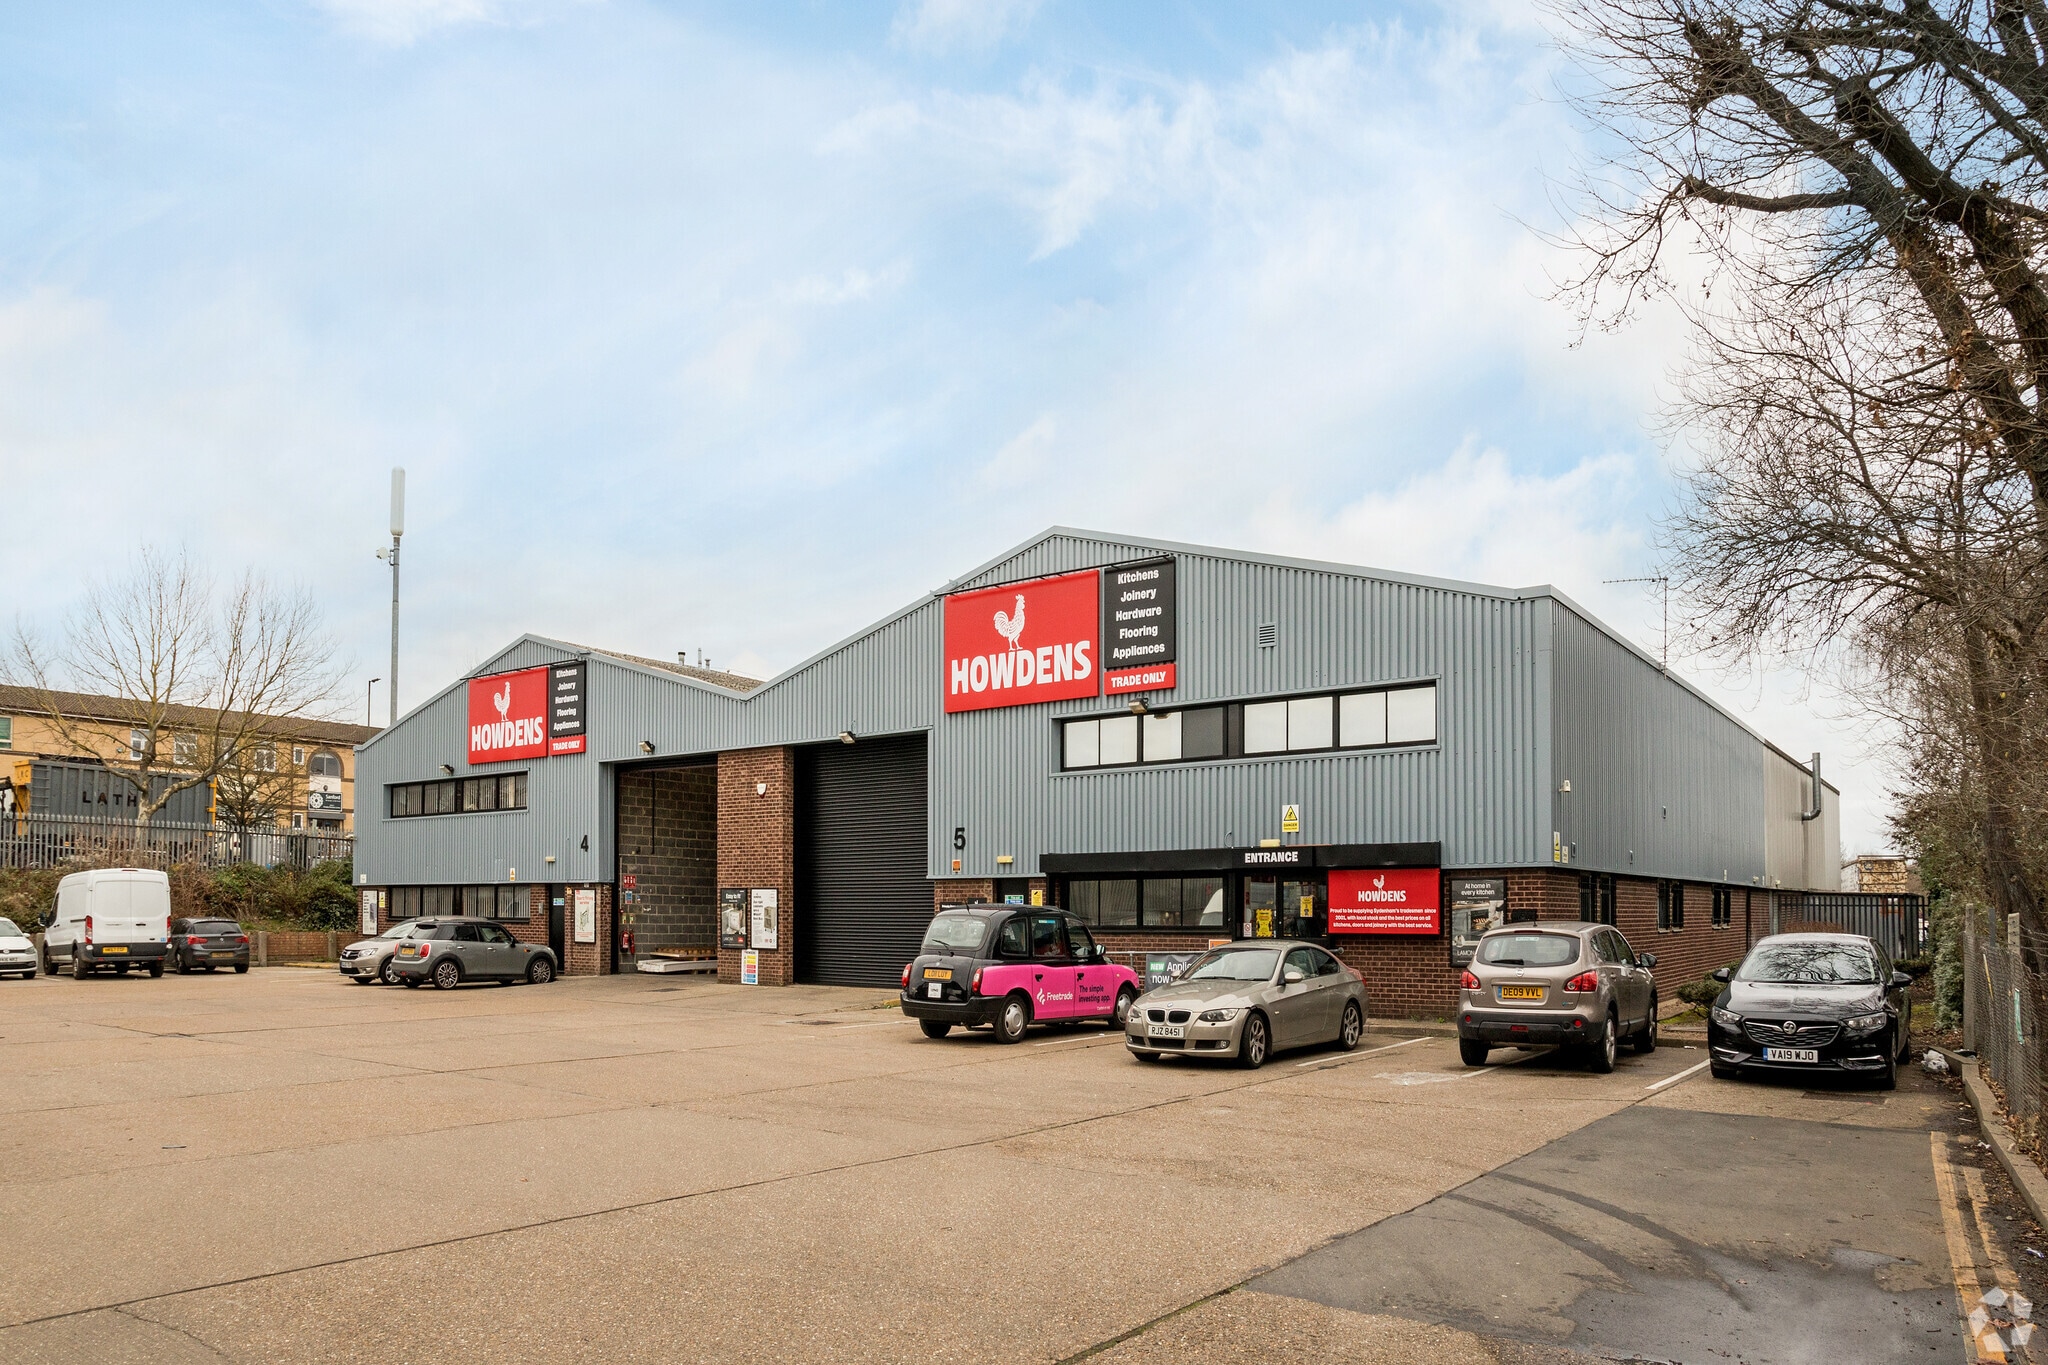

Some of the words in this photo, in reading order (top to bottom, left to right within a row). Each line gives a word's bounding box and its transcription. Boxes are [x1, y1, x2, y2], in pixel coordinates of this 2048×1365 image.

[1118, 568, 1159, 584] Kitchens
[1120, 587, 1156, 602] Joinery
[1116, 605, 1162, 622] Hardware
[1119, 624, 1158, 640] Flooring
[1112, 642, 1165, 661] Appliances
[556, 668, 578, 678] Kitchens
[951, 640, 1092, 695] HOWDENS
[1111, 674, 1141, 688] TRADE
[1142, 671, 1166, 686] ONLY
[558, 682, 576, 691] Joinery
[555, 694, 578, 704] Hardware
[557, 708, 576, 717] Flooring
[553, 720, 580, 731] Appliances
[471, 716, 544, 752] HOWDENS
[552, 742, 568, 751] TRADE
[568, 740, 580, 749] ONLY
[580, 834, 589, 852] 4
[953, 827, 966, 850] 5
[1244, 851, 1298, 864] ENTRANCE
[1358, 890, 1406, 902] HOWDENS
[1150, 963, 1165, 971] NEW
[1152, 975, 1170, 984] now
[1089, 985, 1104, 994] simple
[1503, 987, 1524, 997] DE09
[1526, 988, 1541, 997] VVL
[1046, 992, 1073, 1001] Freetrade
[1079, 995, 1100, 1003] investing
[1151, 1026, 1164, 1035] RJZ
[1165, 1028, 1180, 1036] 8451
[1771, 1050, 1792, 1059] VA19
[1794, 1051, 1814, 1060] WJO
